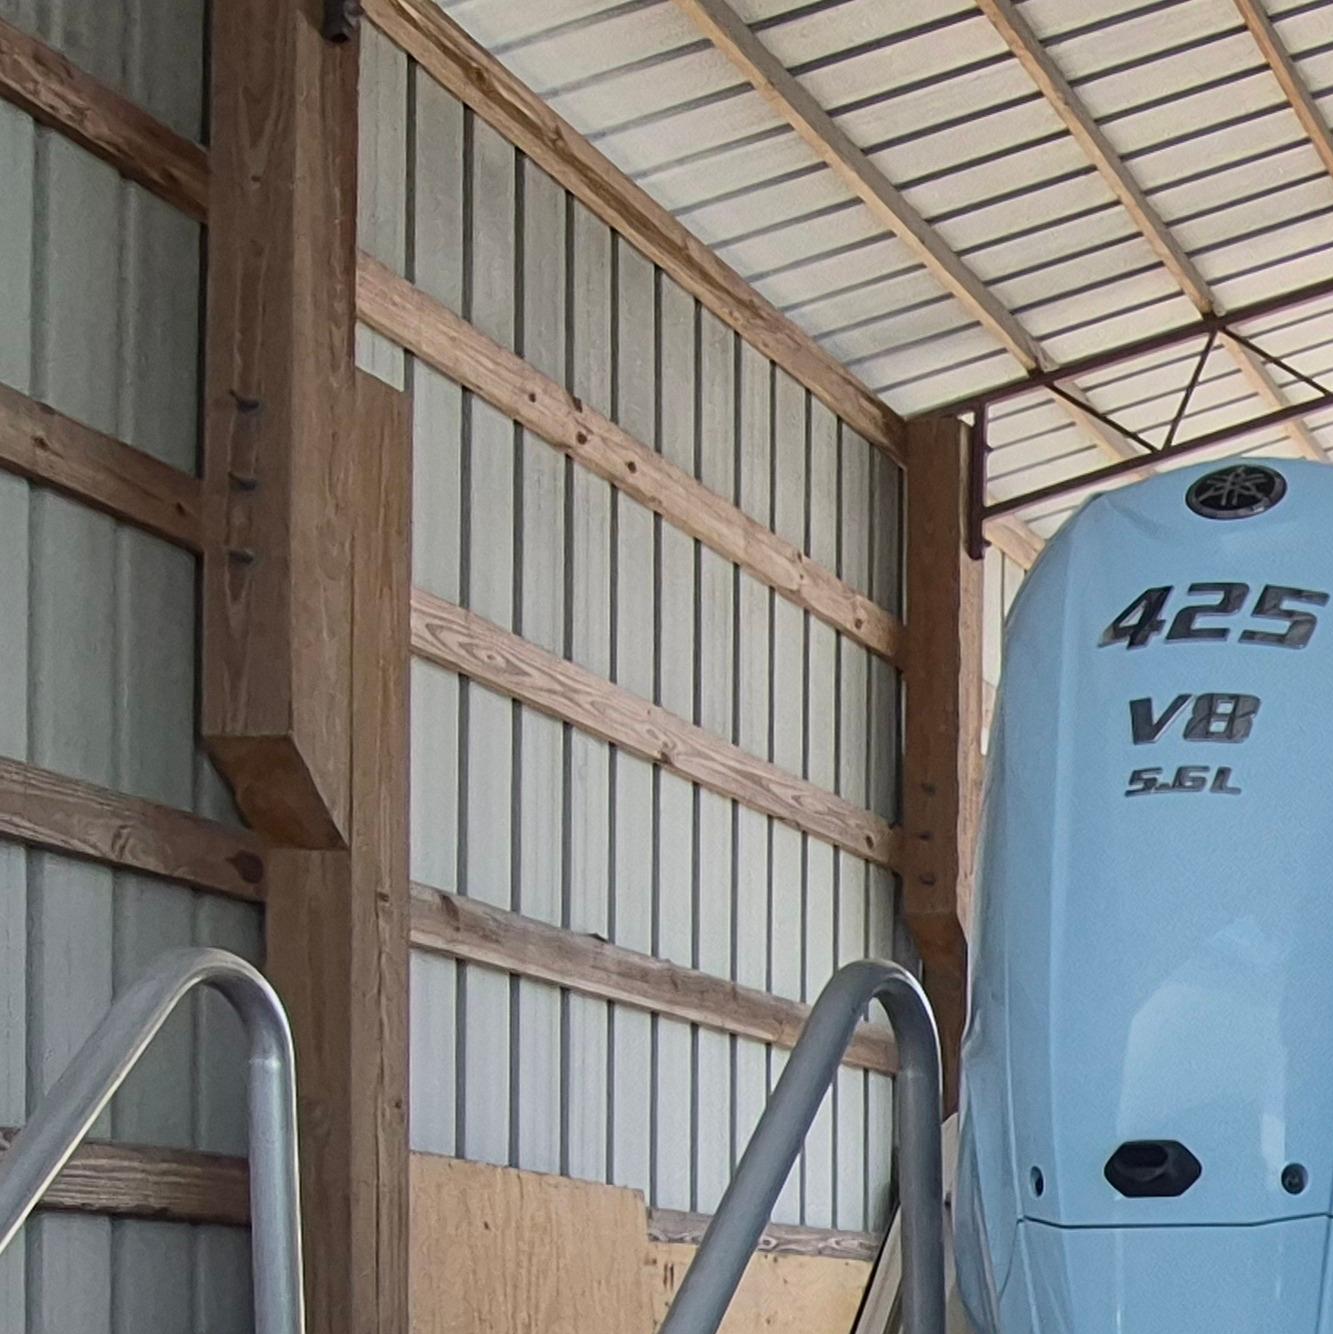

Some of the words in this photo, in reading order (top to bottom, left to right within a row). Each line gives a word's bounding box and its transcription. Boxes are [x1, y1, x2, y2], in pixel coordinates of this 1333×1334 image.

[1098, 582, 1330, 650] 425
[1128, 692, 1262, 745] V8
[1124, 765, 1243, 797] 5.6L
